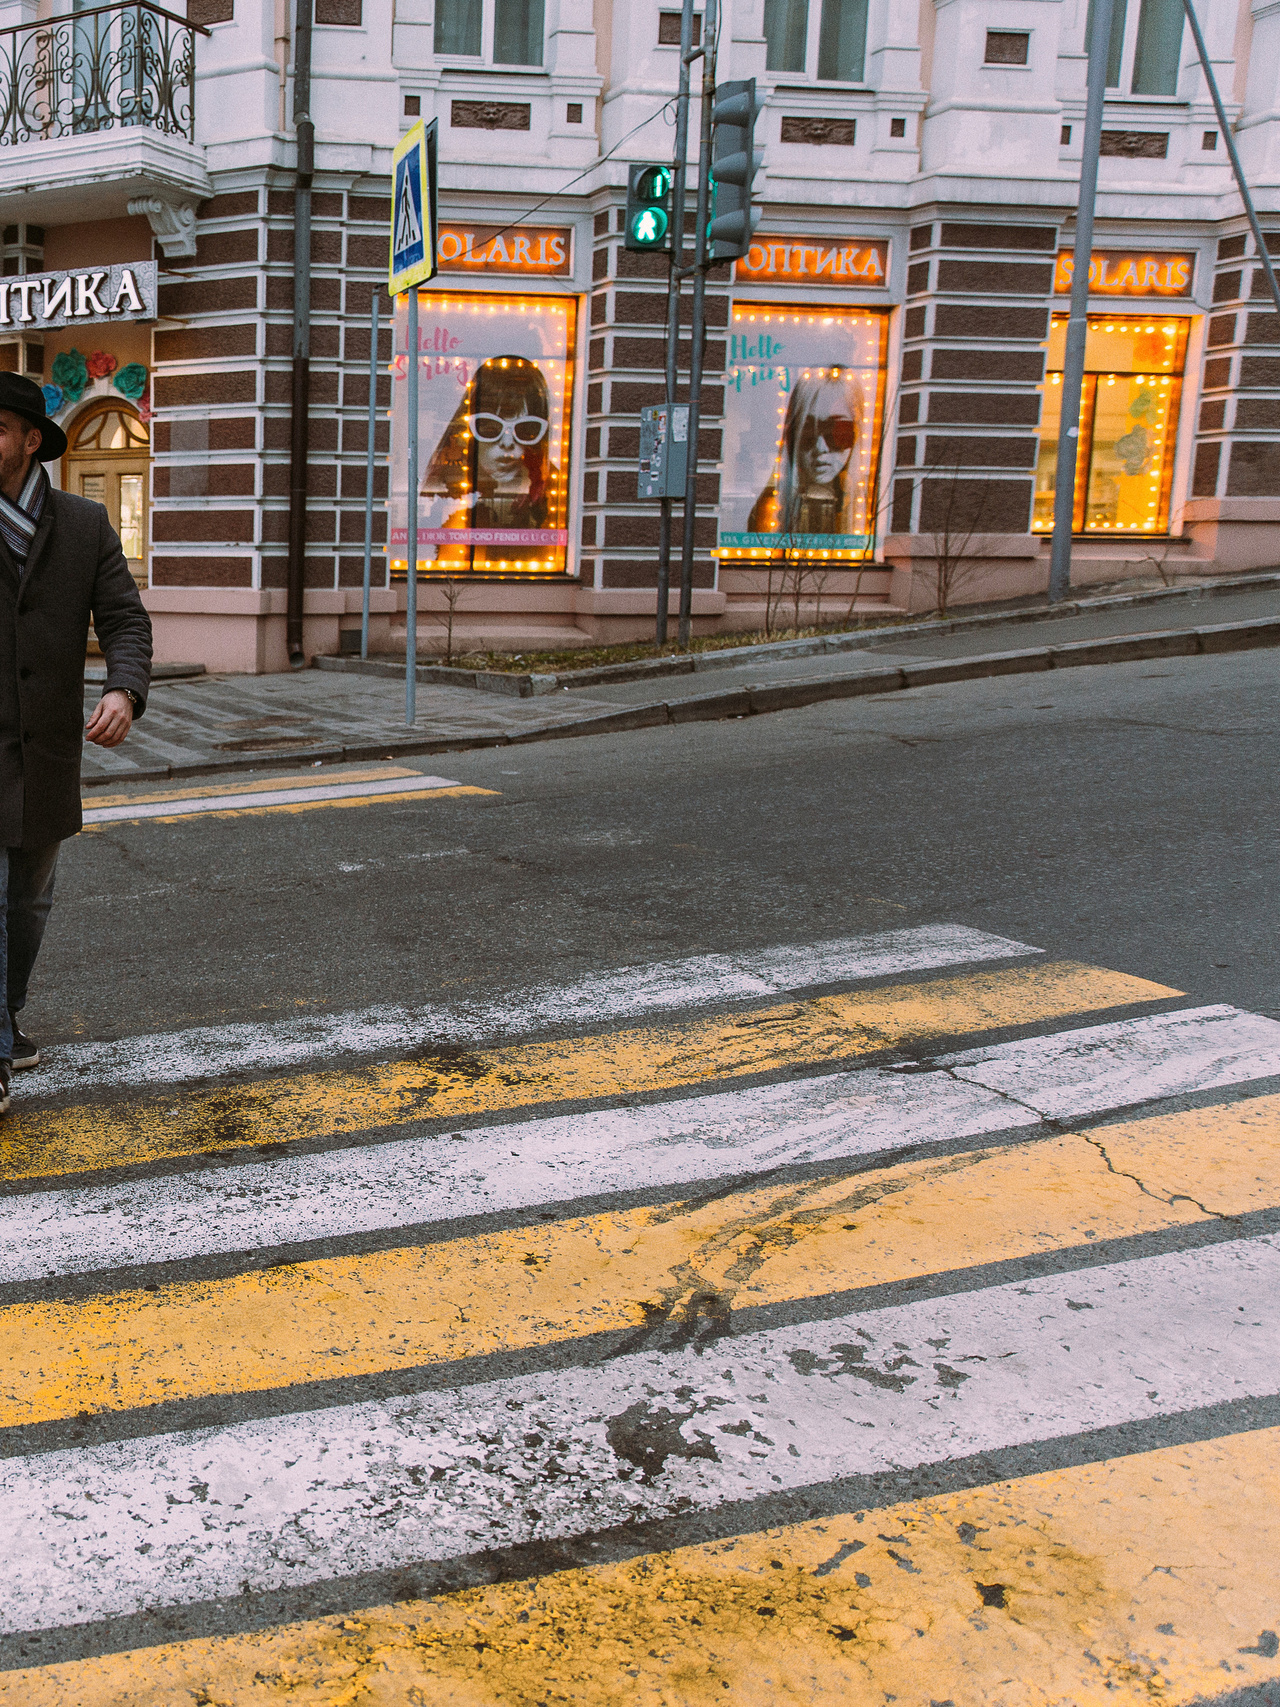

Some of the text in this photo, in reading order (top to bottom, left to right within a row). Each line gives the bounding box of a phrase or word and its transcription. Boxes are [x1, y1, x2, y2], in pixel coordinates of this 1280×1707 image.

[437, 233, 566, 266] OLARIS
[743, 244, 883, 276] ОПТИКА
[731, 334, 786, 359] Hello
[449, 532, 468, 541] TOM
[470, 532, 493, 541] FORD
[494, 532, 520, 542] FENDI
[521, 533, 564, 543] GUCCI
